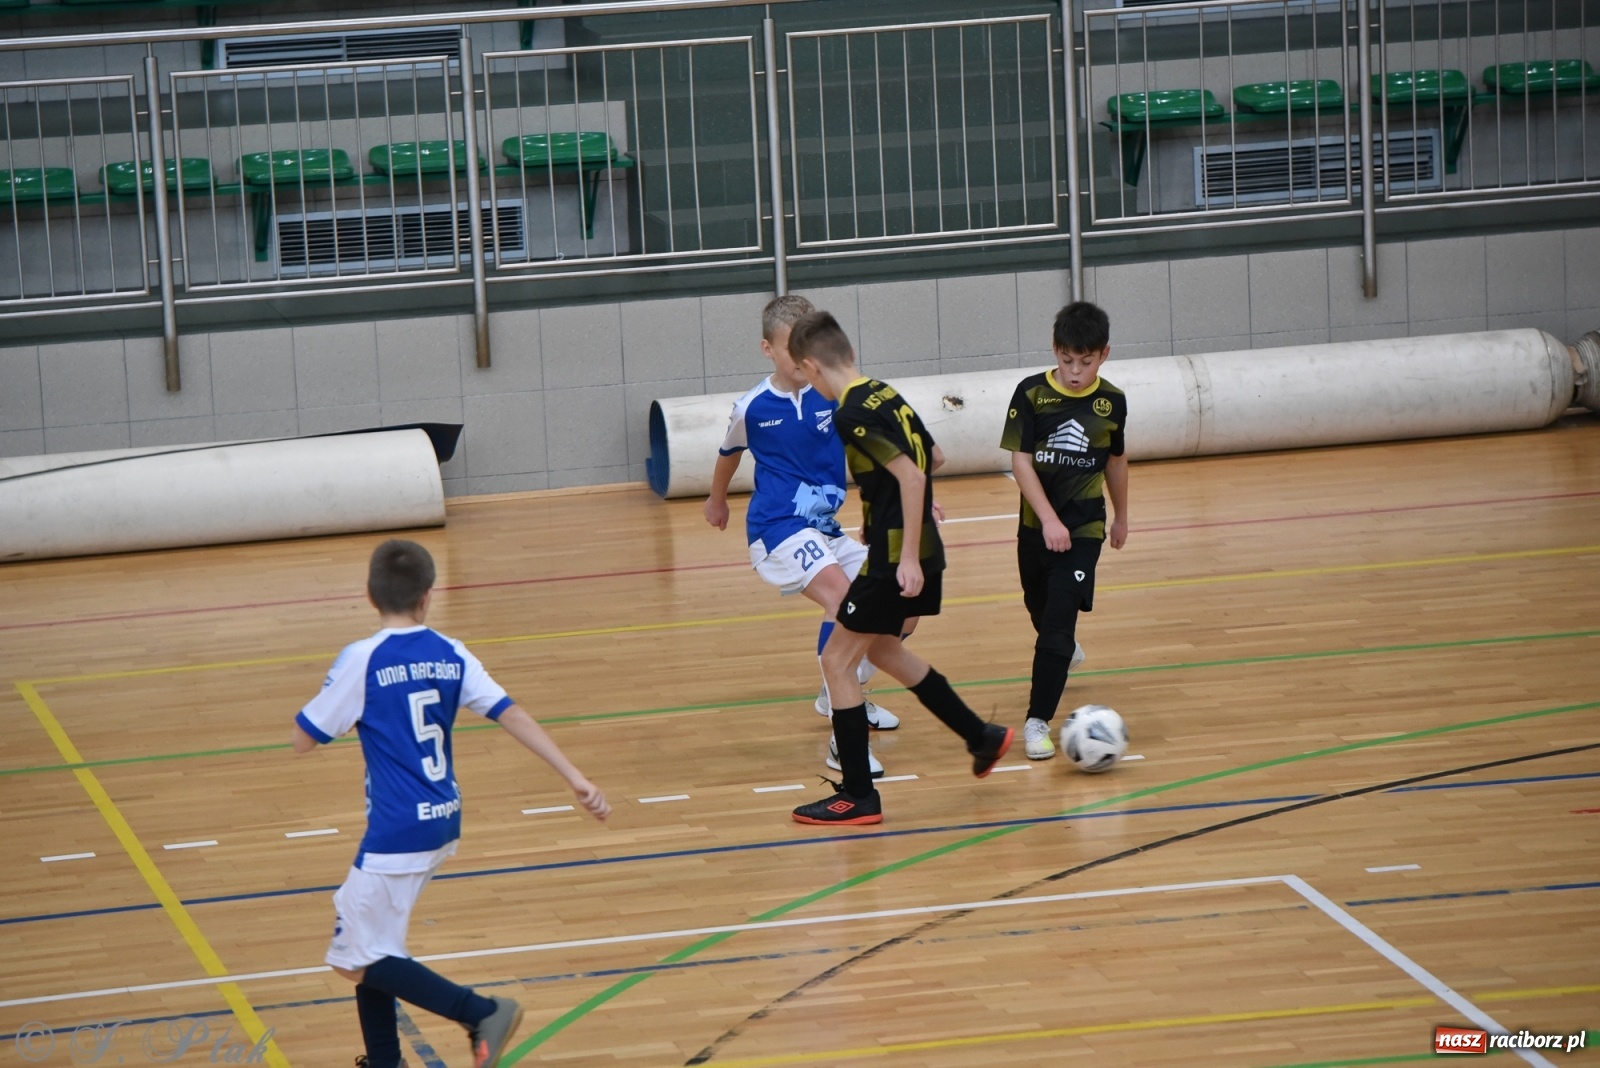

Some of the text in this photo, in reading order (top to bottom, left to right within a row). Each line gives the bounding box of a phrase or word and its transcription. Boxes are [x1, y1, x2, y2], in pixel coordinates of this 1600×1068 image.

[1035, 450, 1096, 468] GH Invest
[793, 539, 825, 572] 28
[376, 665, 408, 687] UNIA
[407, 688, 448, 783] 5
